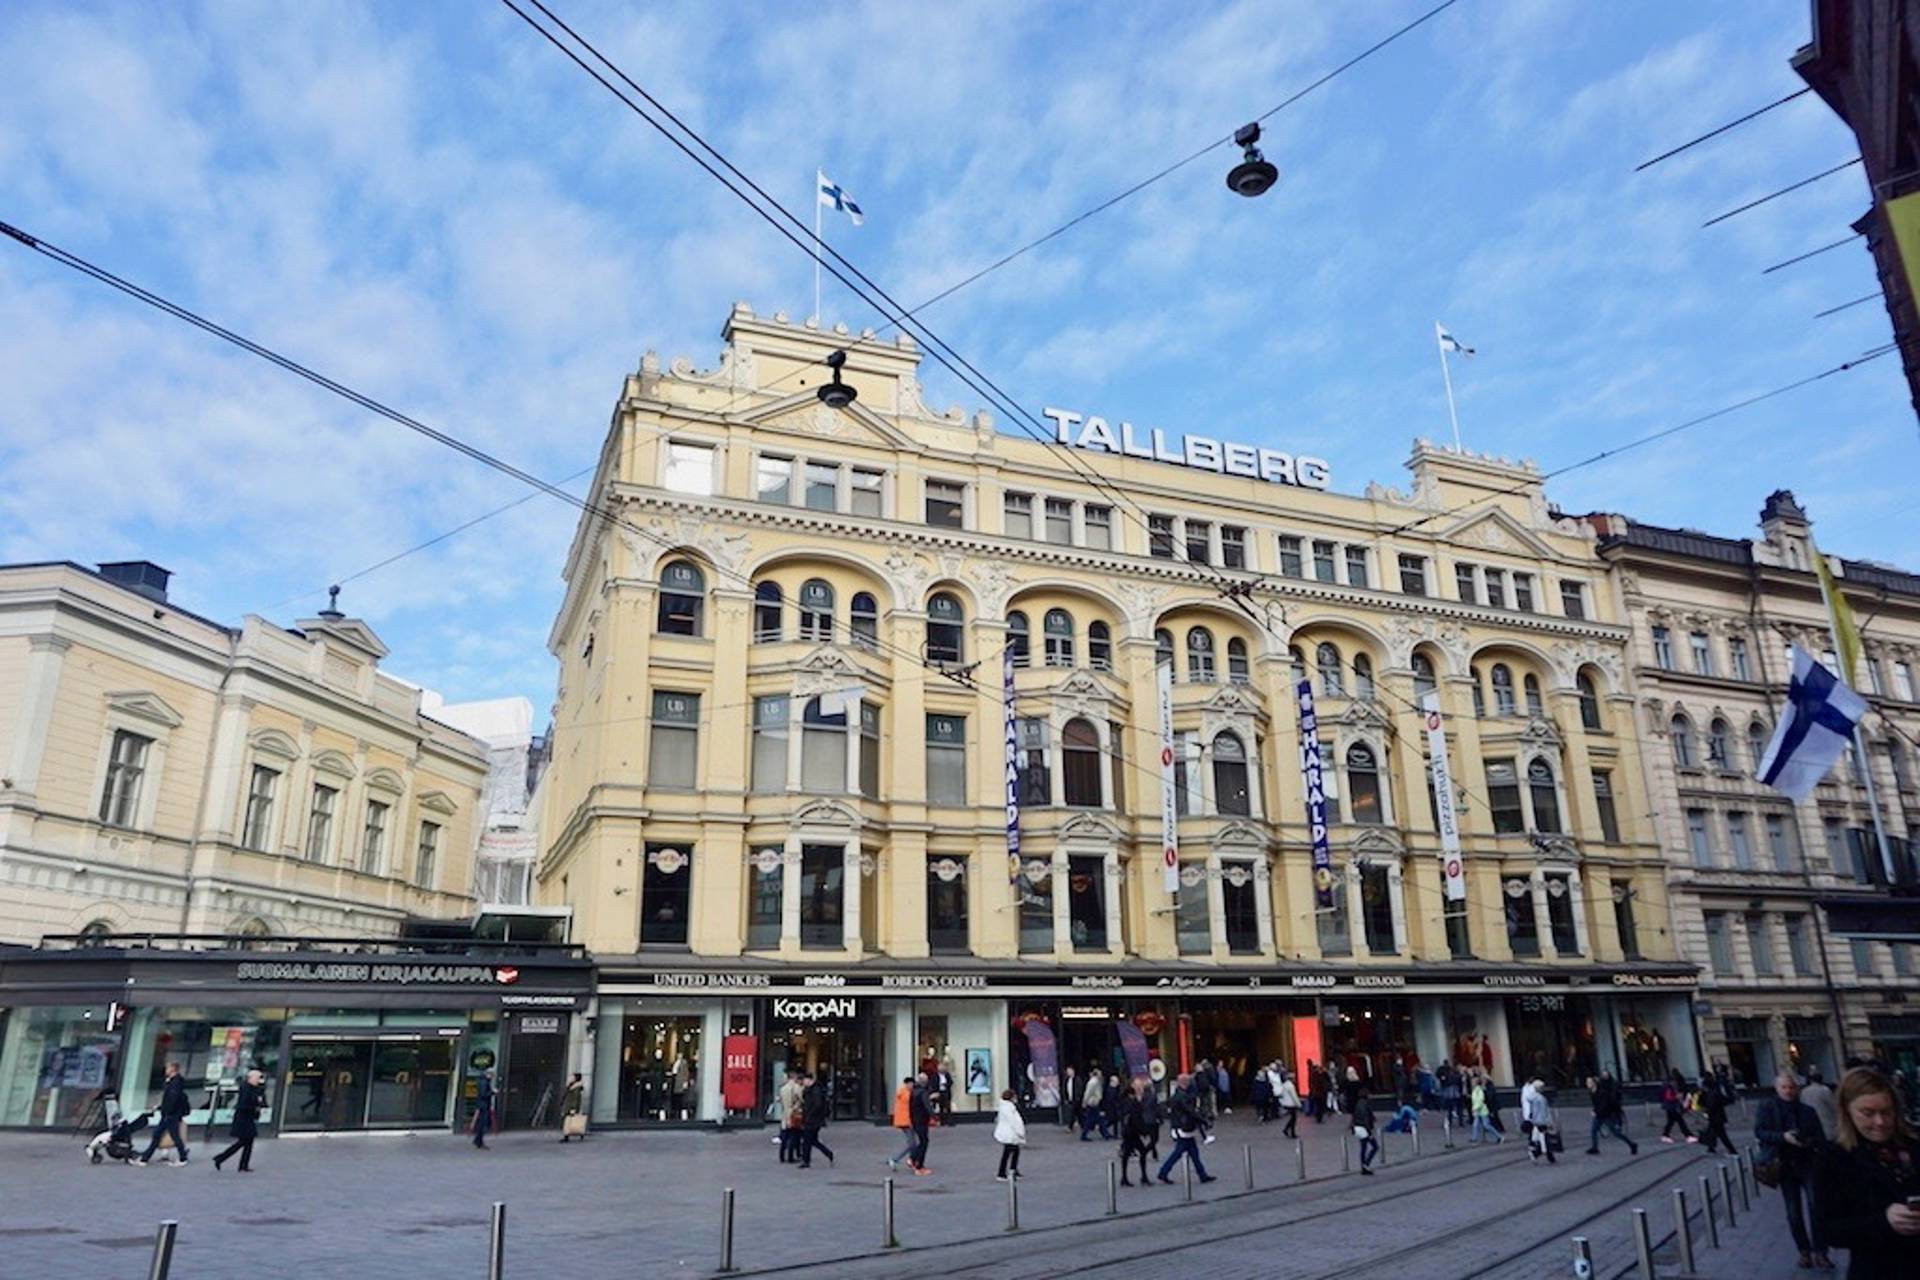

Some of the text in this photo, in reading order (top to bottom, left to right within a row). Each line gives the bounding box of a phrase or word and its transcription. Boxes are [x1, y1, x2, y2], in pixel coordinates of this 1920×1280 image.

[1043, 406, 1331, 491] TALLBERG
[1004, 701, 1018, 825] HARALD
[1303, 730, 1325, 843] HARALD
[237, 962, 494, 984] SUOMALAINEN KIRJAKAUPPA
[653, 973, 770, 986] UNITED BANKERS
[882, 976, 988, 987] ROBERT'S COFFEE
[1292, 976, 1336, 987] HARALD
[773, 998, 856, 1021] KappAhl
[727, 1054, 753, 1068] SALE
